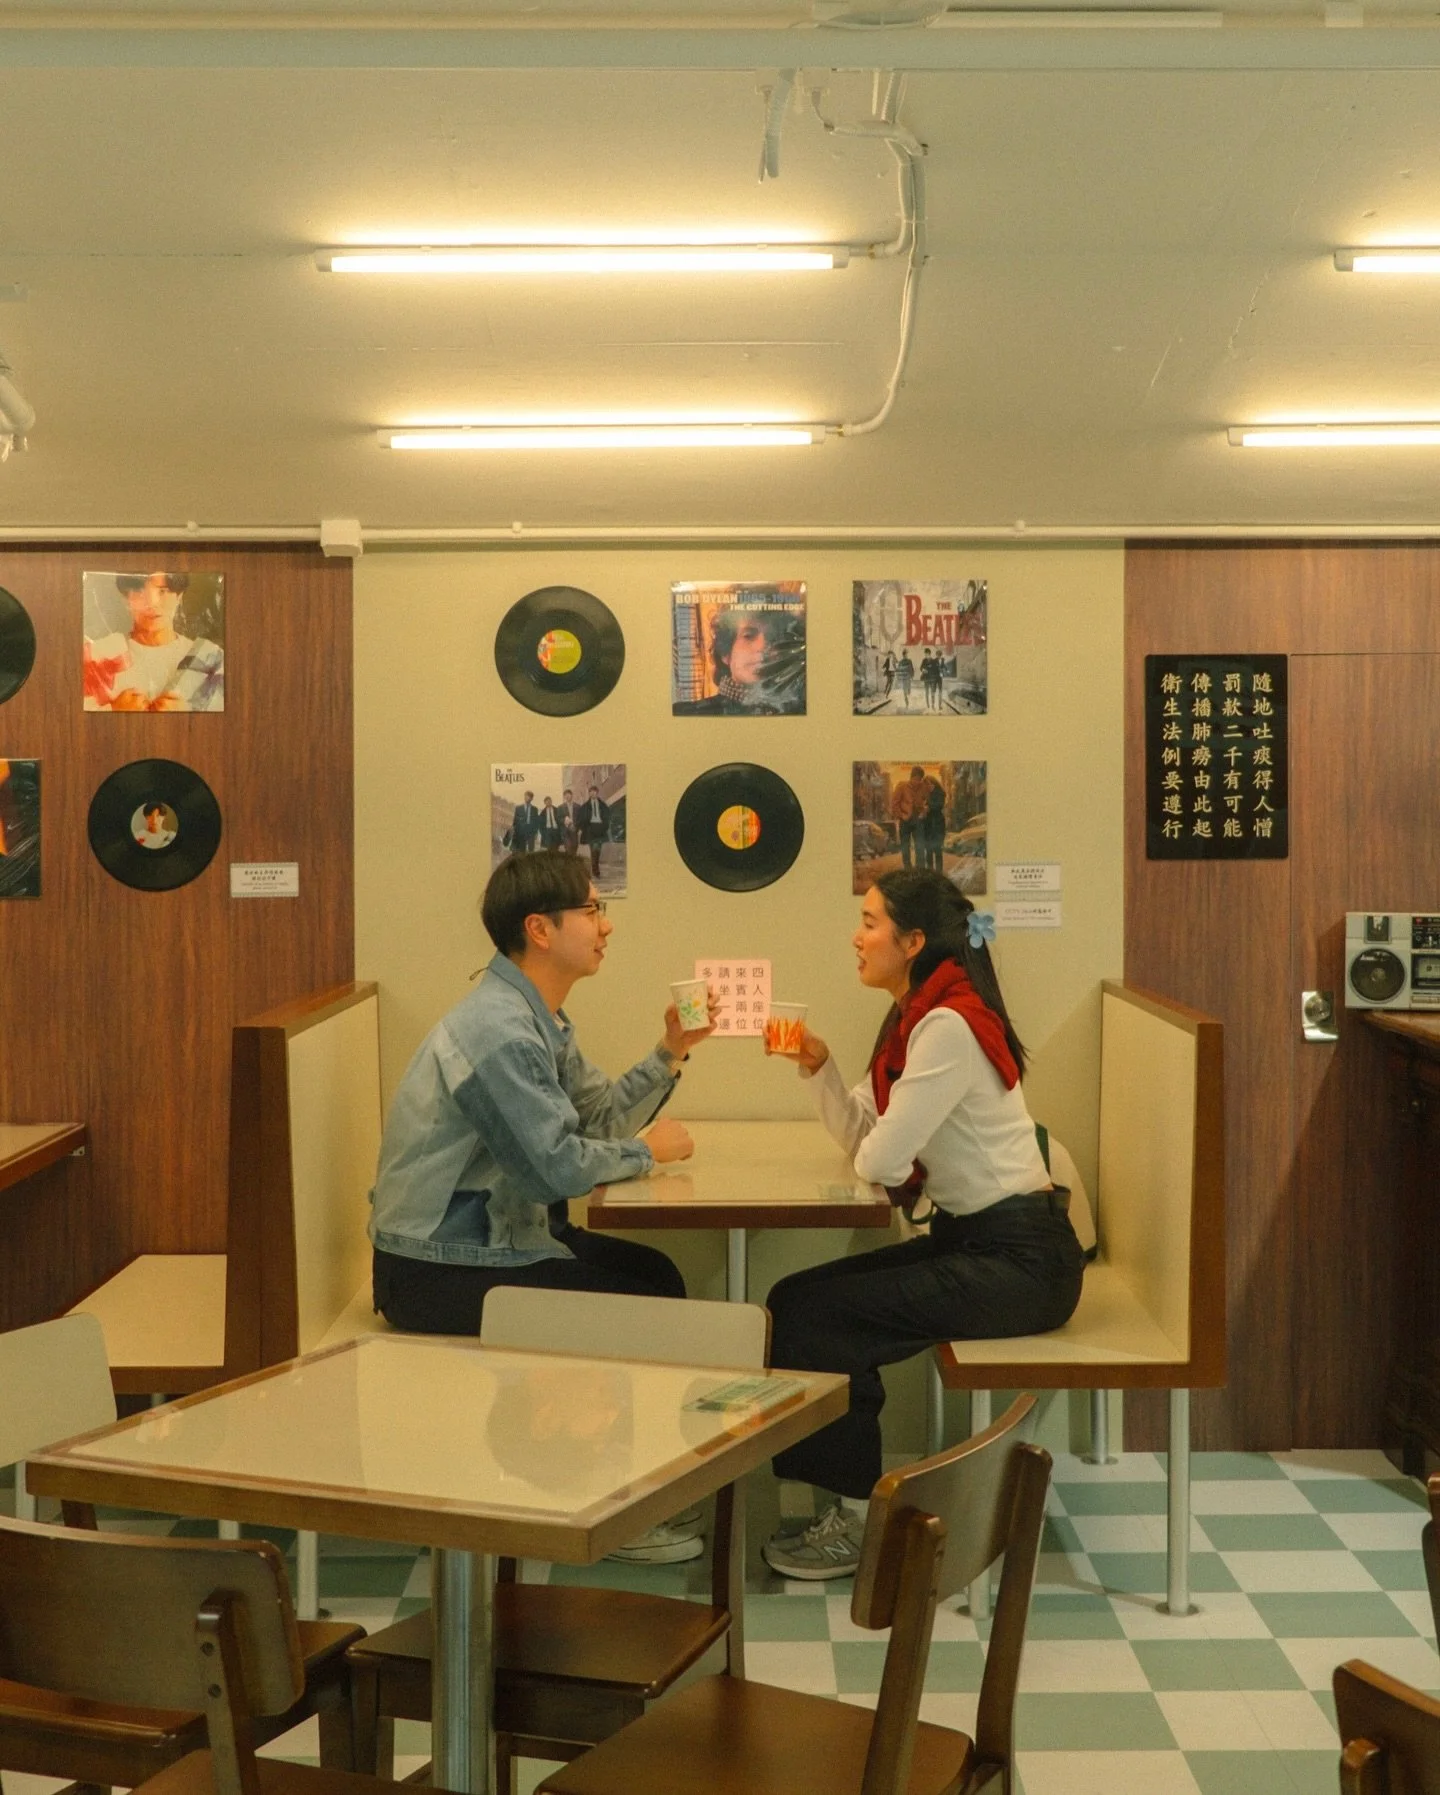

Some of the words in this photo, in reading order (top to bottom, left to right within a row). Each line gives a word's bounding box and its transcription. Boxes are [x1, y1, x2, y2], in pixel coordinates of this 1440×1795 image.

[676, 593, 698, 604] BOB
[702, 593, 738, 604] DYLAN
[936, 601, 952, 610] THE
[1253, 673, 1274, 838] 隨地吐痰得人憎
[495, 769, 525, 784] BEATLES
